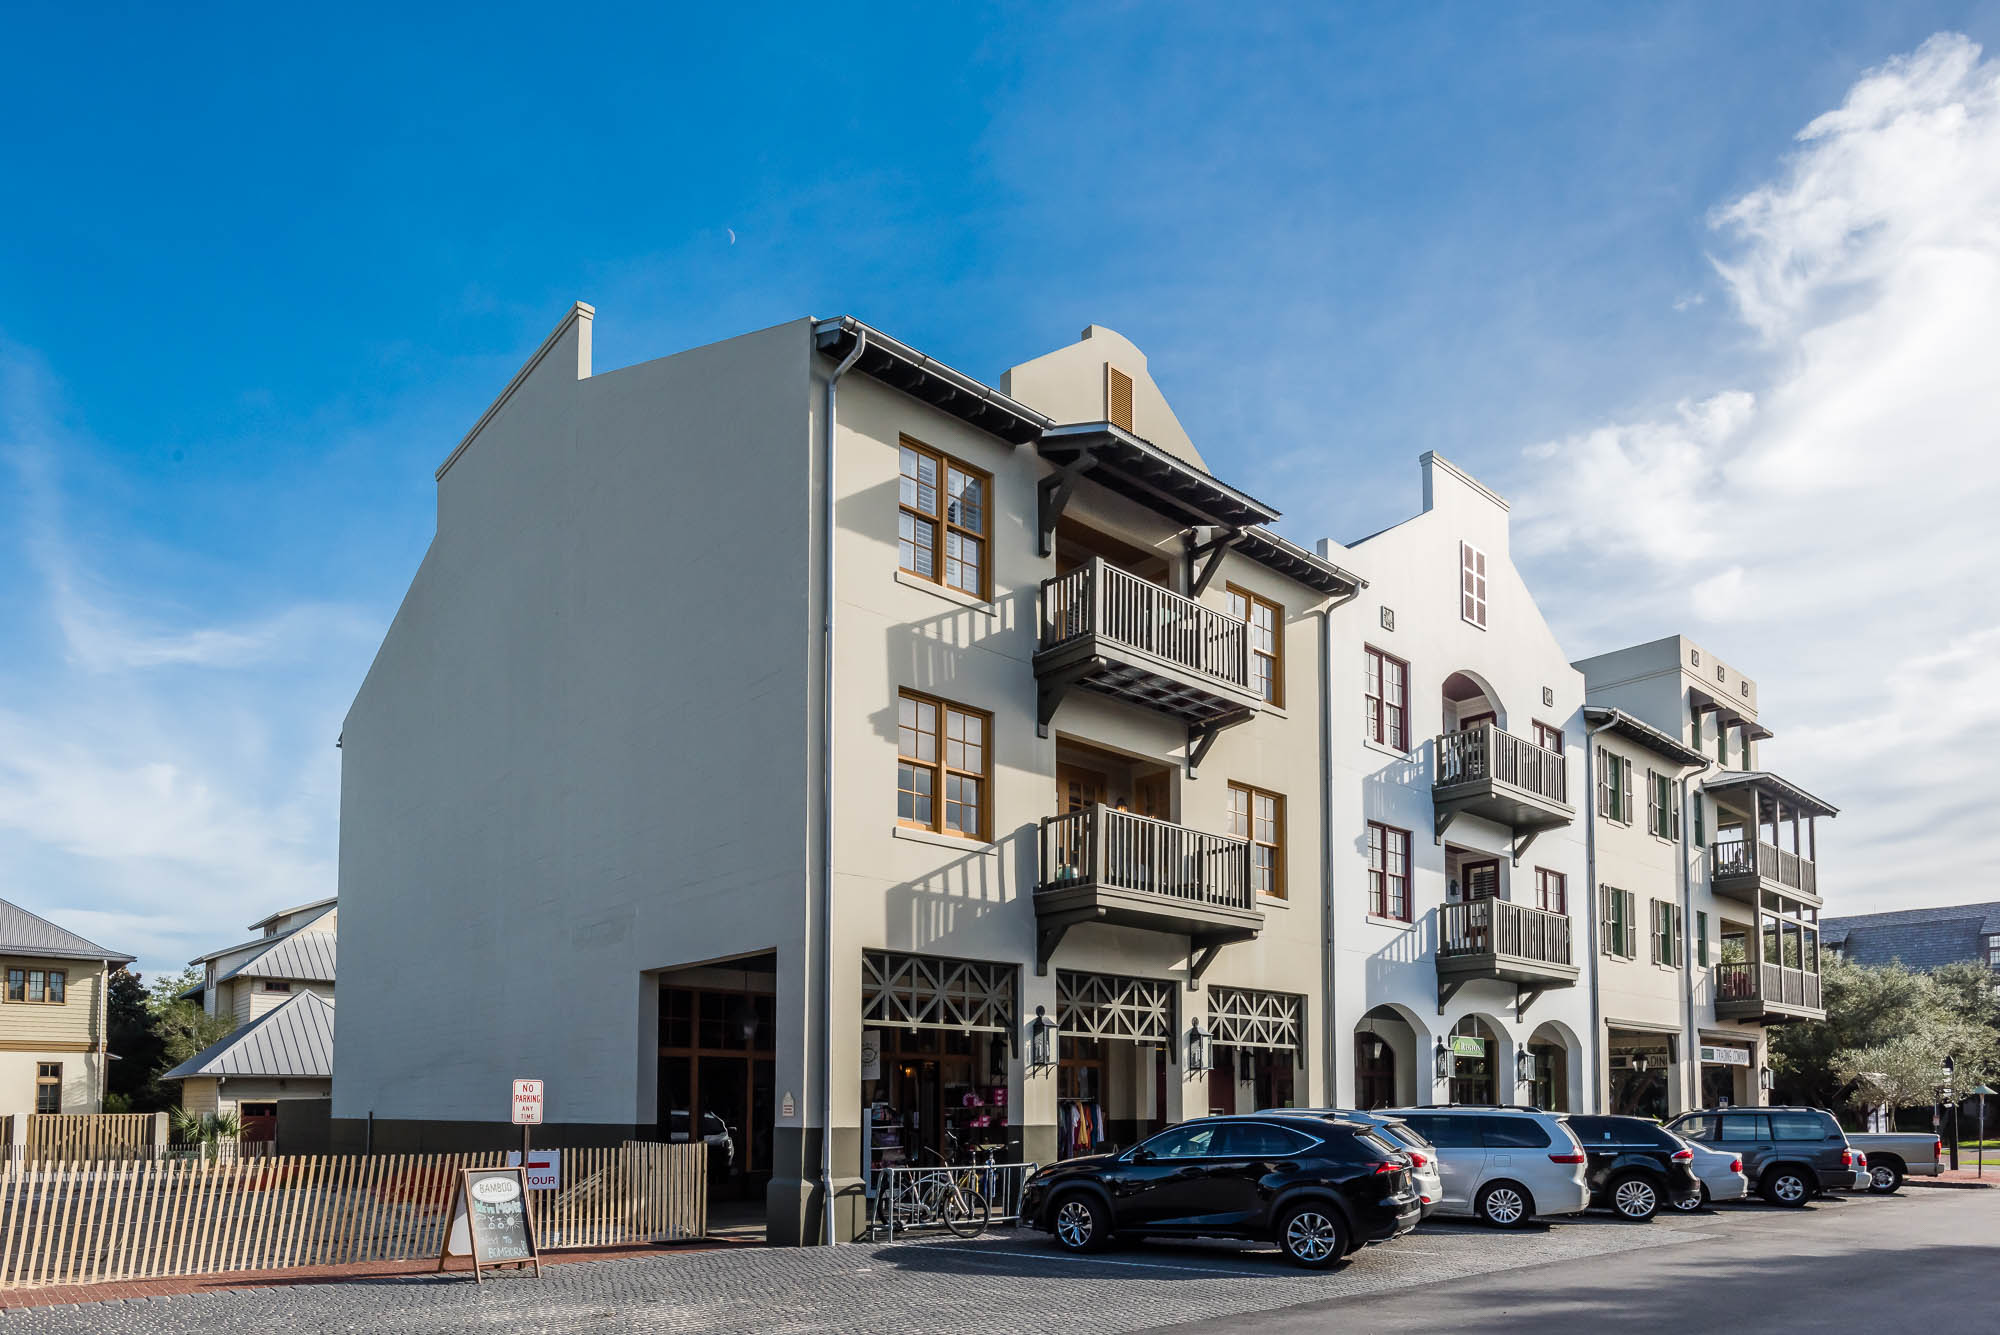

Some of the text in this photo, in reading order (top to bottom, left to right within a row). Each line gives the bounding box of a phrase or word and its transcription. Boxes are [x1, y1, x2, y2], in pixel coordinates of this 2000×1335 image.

[522, 1084, 534, 1092] NO
[515, 1095, 541, 1103] PARKING
[527, 1176, 555, 1185] TOUR
[479, 1182, 513, 1193] BAMBOO
